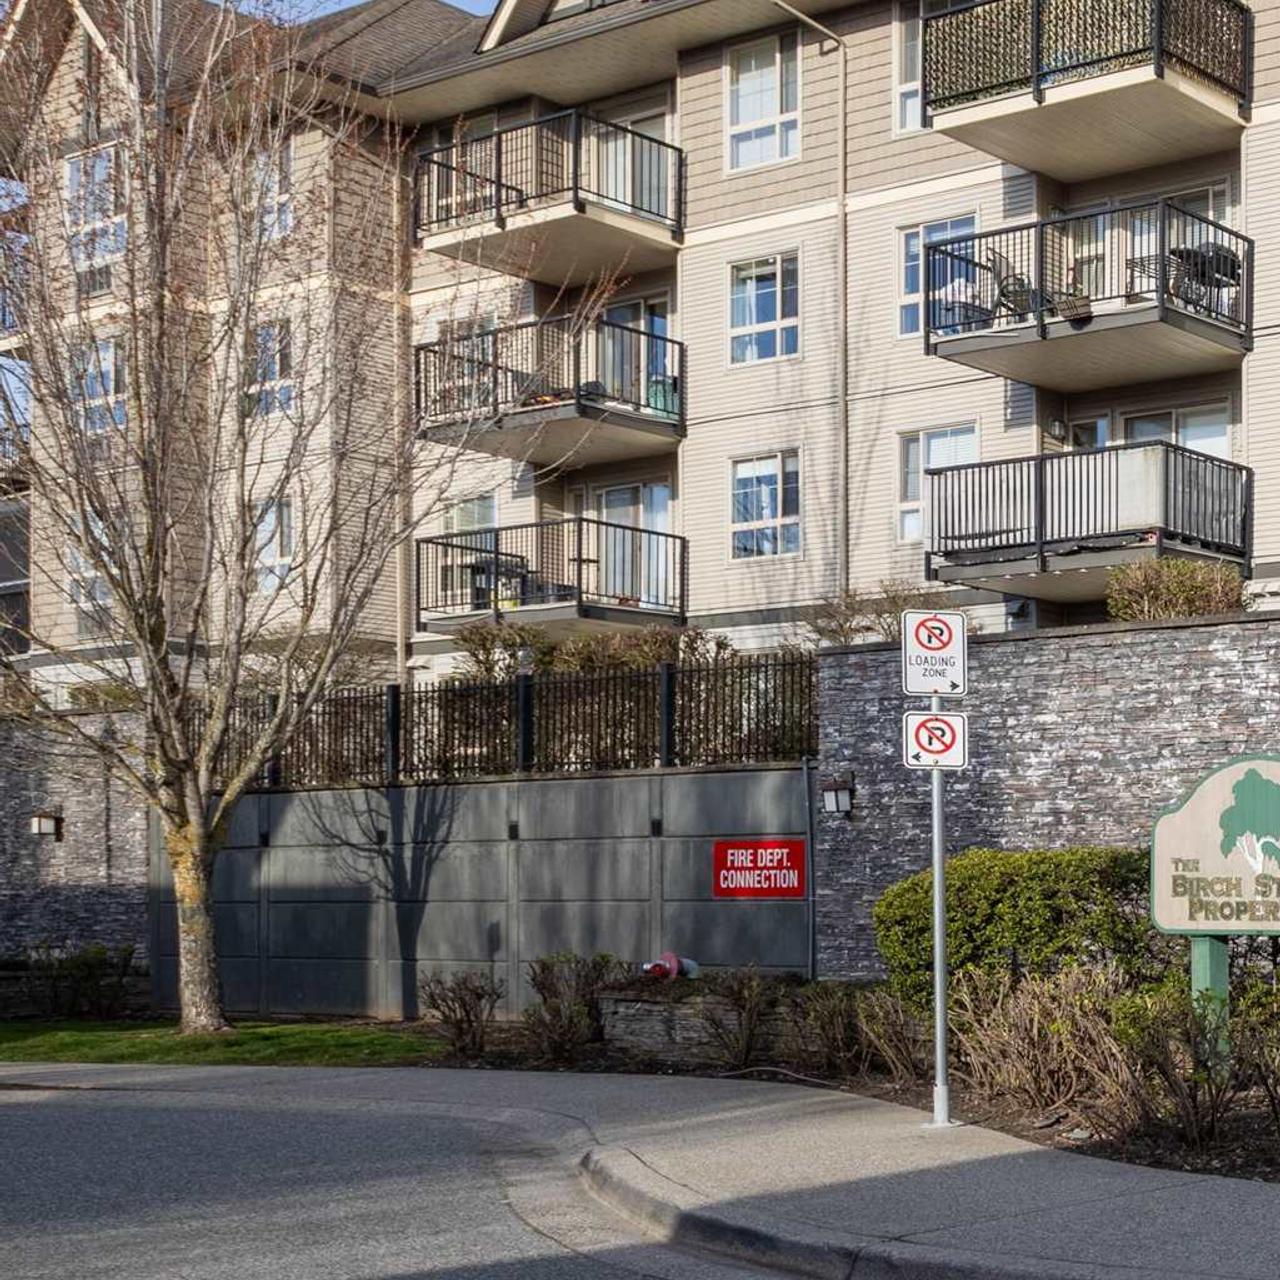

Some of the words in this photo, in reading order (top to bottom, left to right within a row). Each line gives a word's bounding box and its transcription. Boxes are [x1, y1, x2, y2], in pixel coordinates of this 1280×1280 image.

[908, 655, 956, 668] LOADING
[922, 668, 948, 678] ZONE
[727, 849, 754, 868] FIRE
[757, 848, 791, 867] DEPT.
[720, 869, 799, 889] CONNECTION
[1171, 874, 1242, 898] BIRCH
